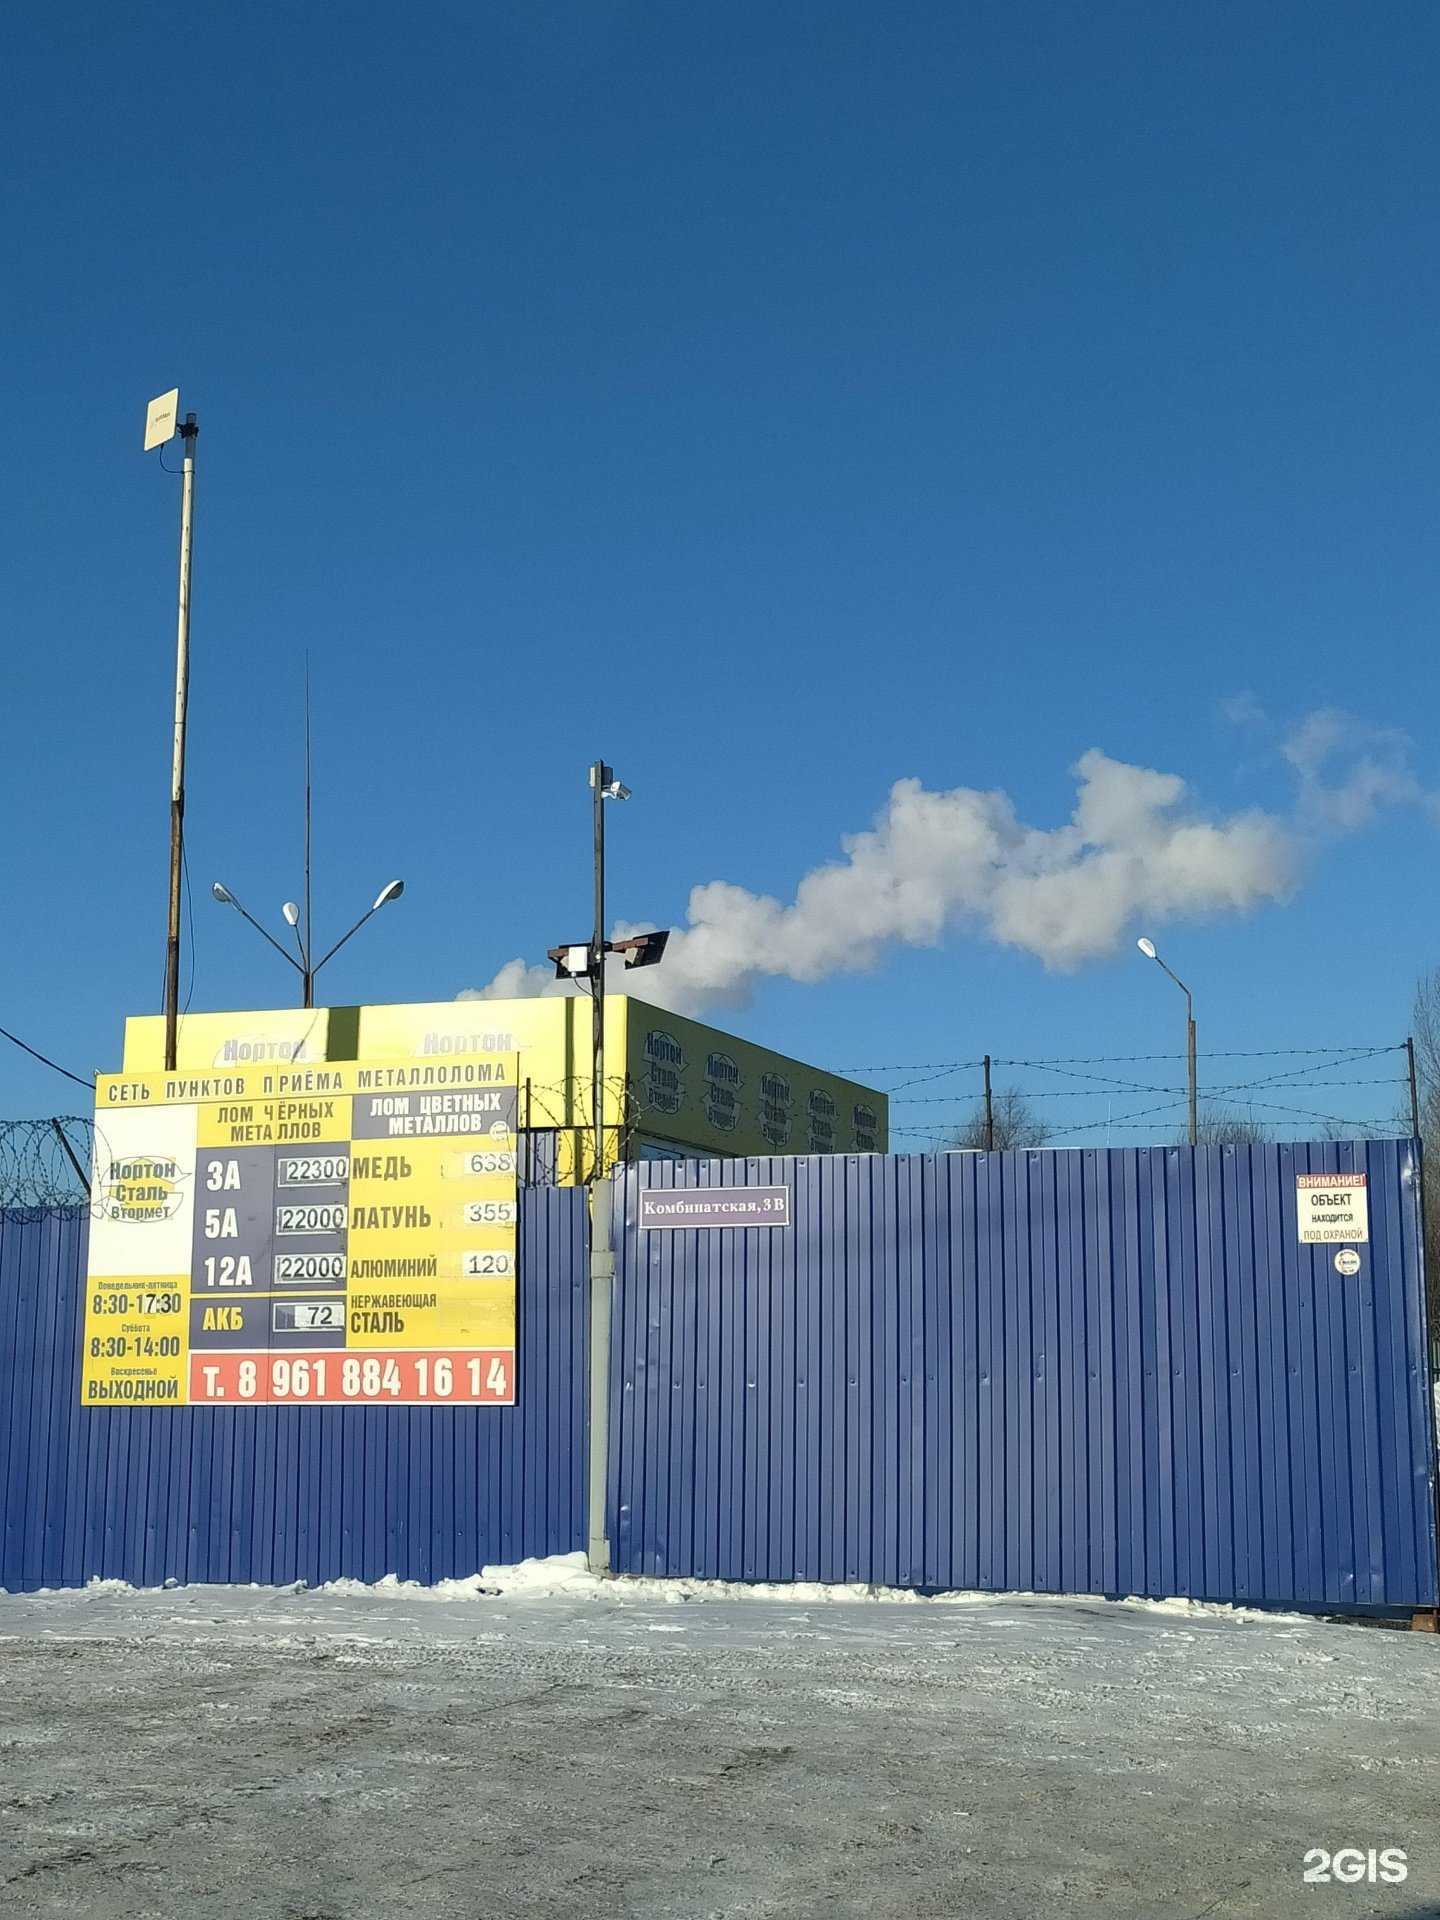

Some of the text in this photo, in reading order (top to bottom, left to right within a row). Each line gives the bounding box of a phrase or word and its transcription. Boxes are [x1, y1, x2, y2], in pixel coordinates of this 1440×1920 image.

[423, 1033, 512, 1056] Нортон
[109, 1084, 150, 1101] СЕТЬ
[166, 1078, 245, 1099] ПУНКТОВ
[358, 1063, 506, 1088] МЕТАЛЛОЛОМА
[217, 1100, 334, 1124] ЛОМ ЧЁРНЫХ
[370, 1093, 502, 1117] ЛОМ ЦВЕТНЫХ
[230, 1122, 321, 1142] МЕТАЛЛОВ
[388, 1114, 482, 1136] МЕТАЛЛОВ
[110, 1161, 176, 1181] Нортон
[206, 1158, 347, 1192] 3А 22300
[352, 1156, 412, 1181] МЕДЬ
[116, 1184, 168, 1202] Сталь
[1298, 1175, 1365, 1188] ВНИМАНИЕ!
[1311, 1194, 1352, 1206] ОБЪЕКТ
[111, 1206, 171, 1220] Втормет
[205, 1207, 345, 1239] 5А 22000
[351, 1203, 512, 1230] ЛАТУНЬ 355
[1312, 1214, 1353, 1223] НАХОДИТСЯ
[1304, 1227, 1363, 1241] ПОД ОХРАНОЙ
[204, 1255, 343, 1287] 12А 22000
[350, 1254, 509, 1279] АЛЮМИНИЙ 120
[93, 1293, 181, 1315] 8:30-17:30
[351, 1294, 437, 1309] НЕРЖАВЕЮЩАЯ
[202, 1306, 333, 1331] АКБ 72
[350, 1311, 405, 1334] СТАЛЬ
[90, 1336, 180, 1358] 8:30-14:00
[87, 1375, 179, 1401] ВЫХОДНОЙ
[238, 1360, 257, 1398] 8
[272, 1359, 326, 1397] 961
[341, 1358, 401, 1397] 884
[414, 1357, 453, 1396] 16
[467, 1357, 507, 1397] 14
